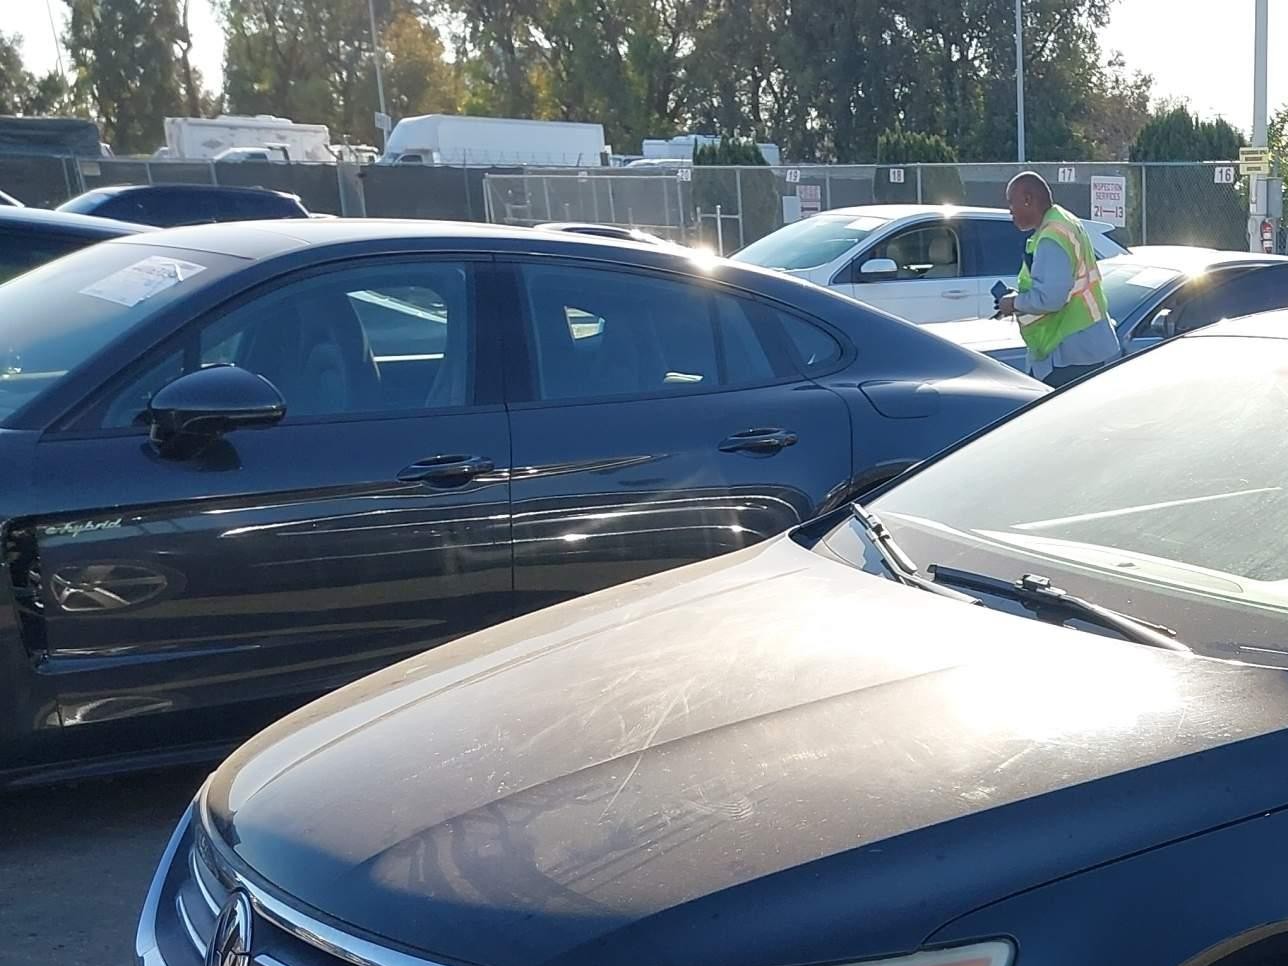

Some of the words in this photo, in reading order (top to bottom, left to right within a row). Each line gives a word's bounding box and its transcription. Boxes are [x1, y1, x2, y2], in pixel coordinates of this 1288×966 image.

[891, 169, 902, 181] 18
[1061, 168, 1073, 182] 17
[1218, 168, 1232, 182] 16
[45, 518, 122, 538] e-hybrid
